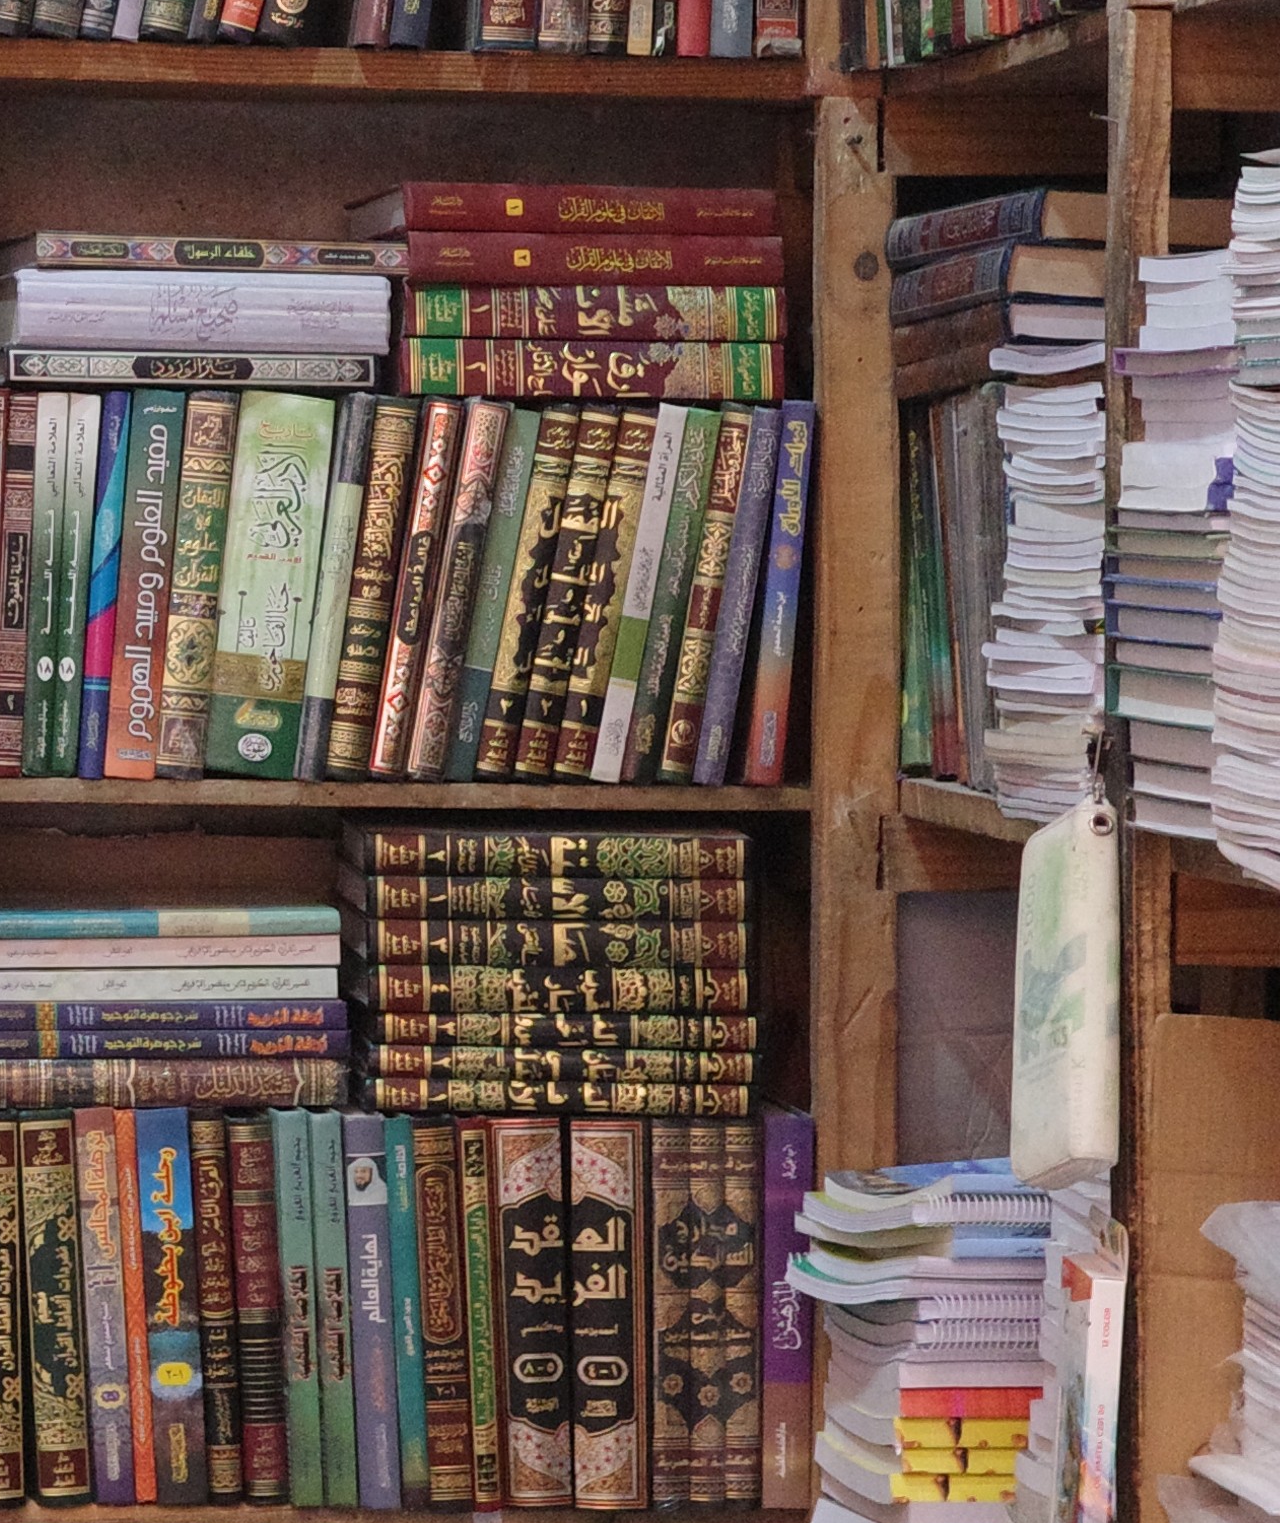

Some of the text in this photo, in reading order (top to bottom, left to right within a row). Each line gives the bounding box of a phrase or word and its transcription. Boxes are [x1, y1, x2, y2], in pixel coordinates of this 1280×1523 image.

[125, 424, 167, 741] مفيد العلوم ومبيد الهموم
[89, 1177, 116, 1258] المجالس
[151, 1147, 183, 1327] رحلة ابن بطوطة
[360, 1233, 392, 1323] نهاية العالم
[1102, 1307, 1111, 1338] COLOR
